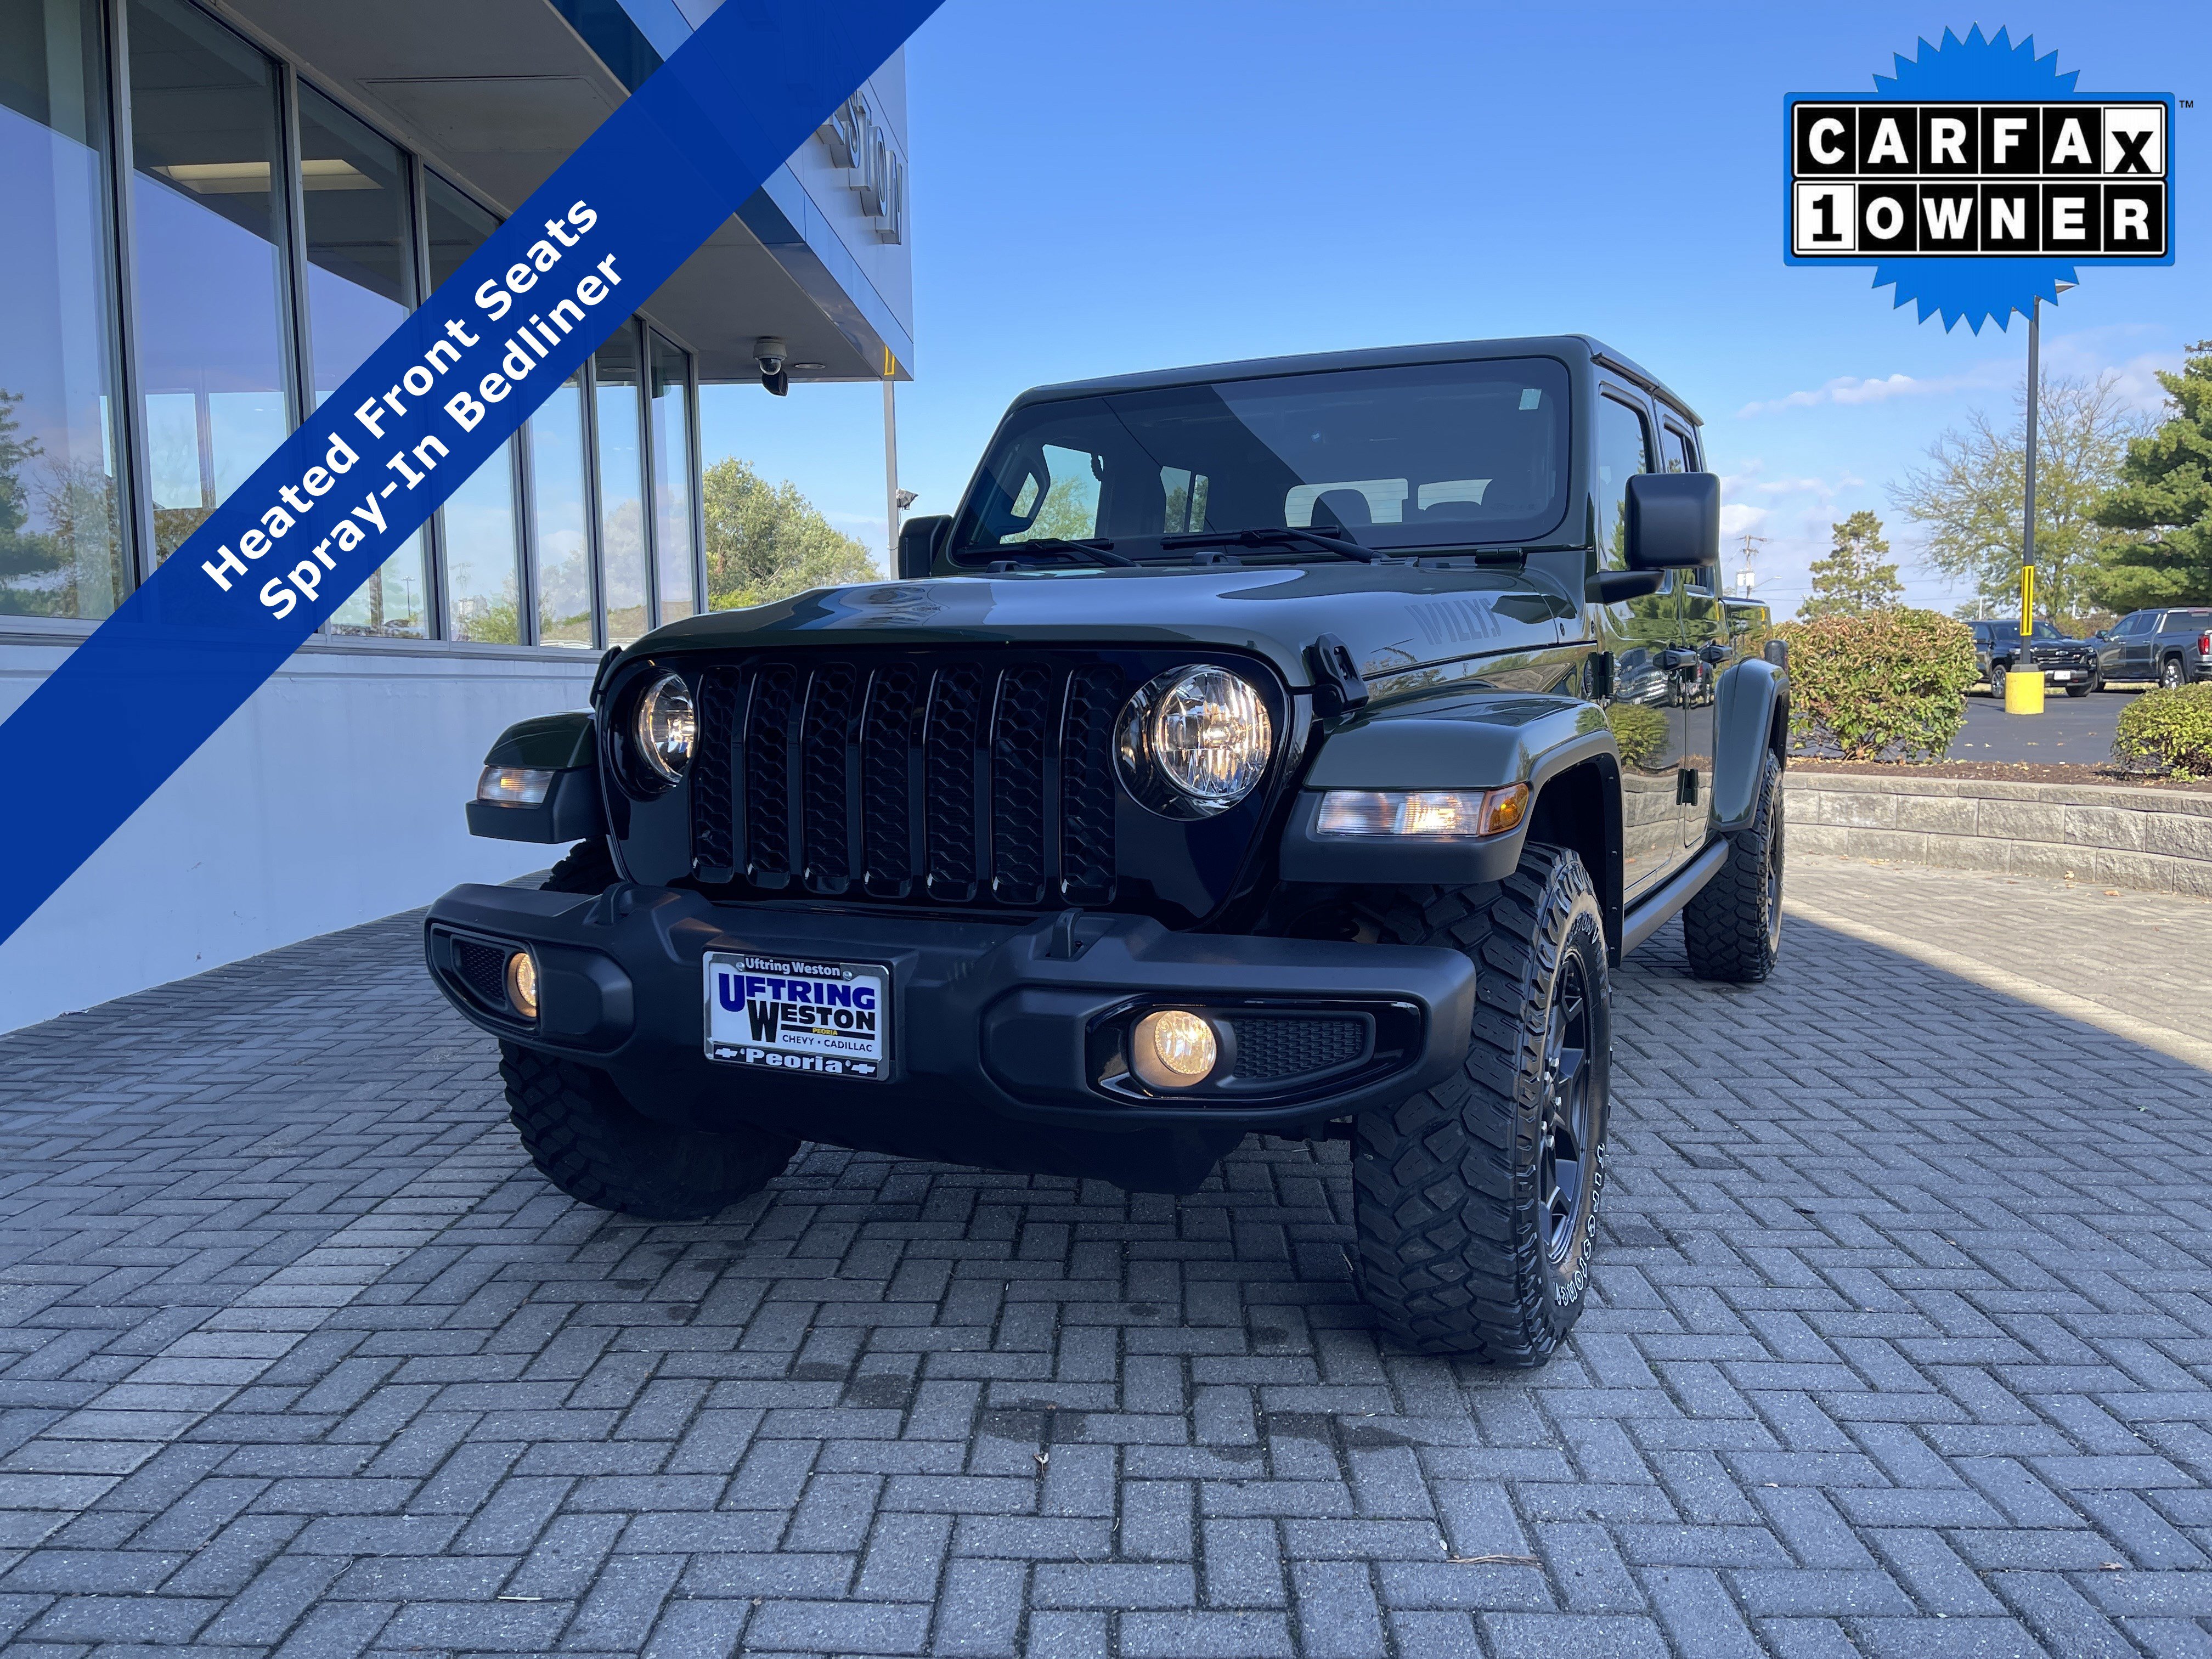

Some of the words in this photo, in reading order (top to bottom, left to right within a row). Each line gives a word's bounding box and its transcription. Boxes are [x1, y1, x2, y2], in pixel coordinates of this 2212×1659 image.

[1404, 598, 1501, 645] WILLYS
[745, 957, 790, 974] Uftring
[792, 962, 840, 976] Weston
[719, 973, 875, 1012] UFTRING
[747, 999, 875, 1043] WESTON
[812, 1028, 838, 1036] PEORIA
[782, 1035, 814, 1045] CHEVY
[824, 1040, 873, 1052] CADILLAC
[745, 1048, 843, 1074] Peoria
